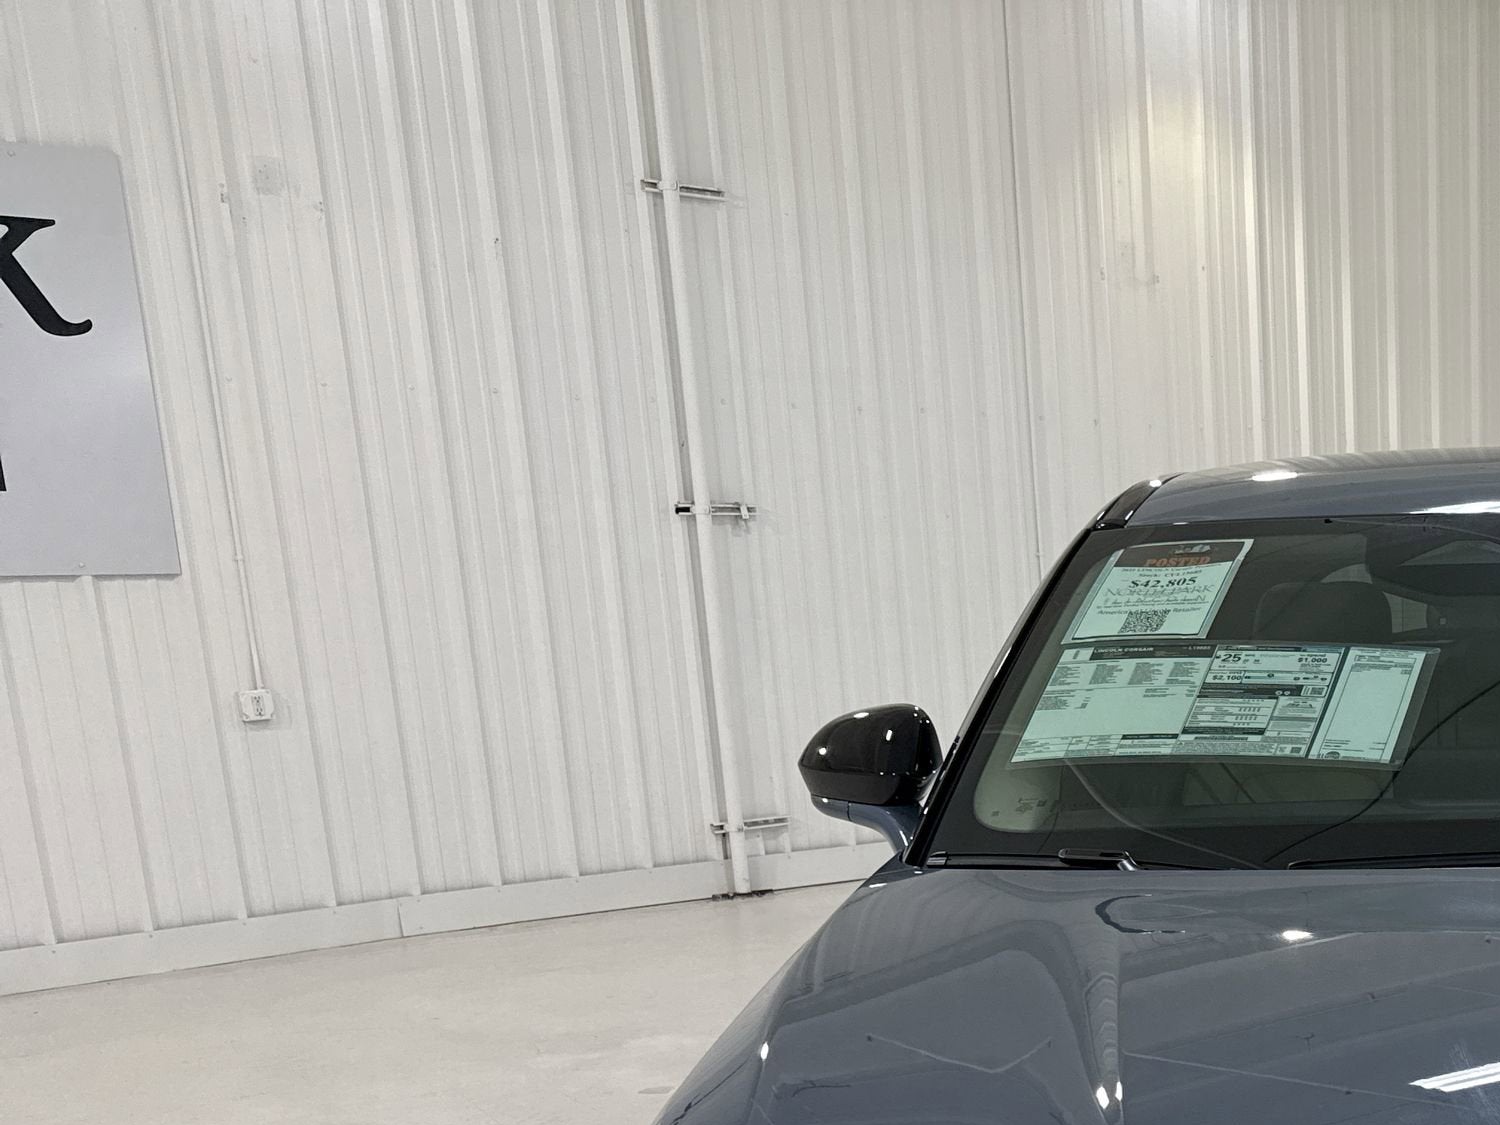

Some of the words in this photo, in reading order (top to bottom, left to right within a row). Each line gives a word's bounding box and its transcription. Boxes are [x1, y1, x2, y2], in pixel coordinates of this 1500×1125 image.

[1144, 556, 1211, 567] POSTED
[1128, 576, 1198, 588] $42,805
[1221, 653, 1242, 663] 25
